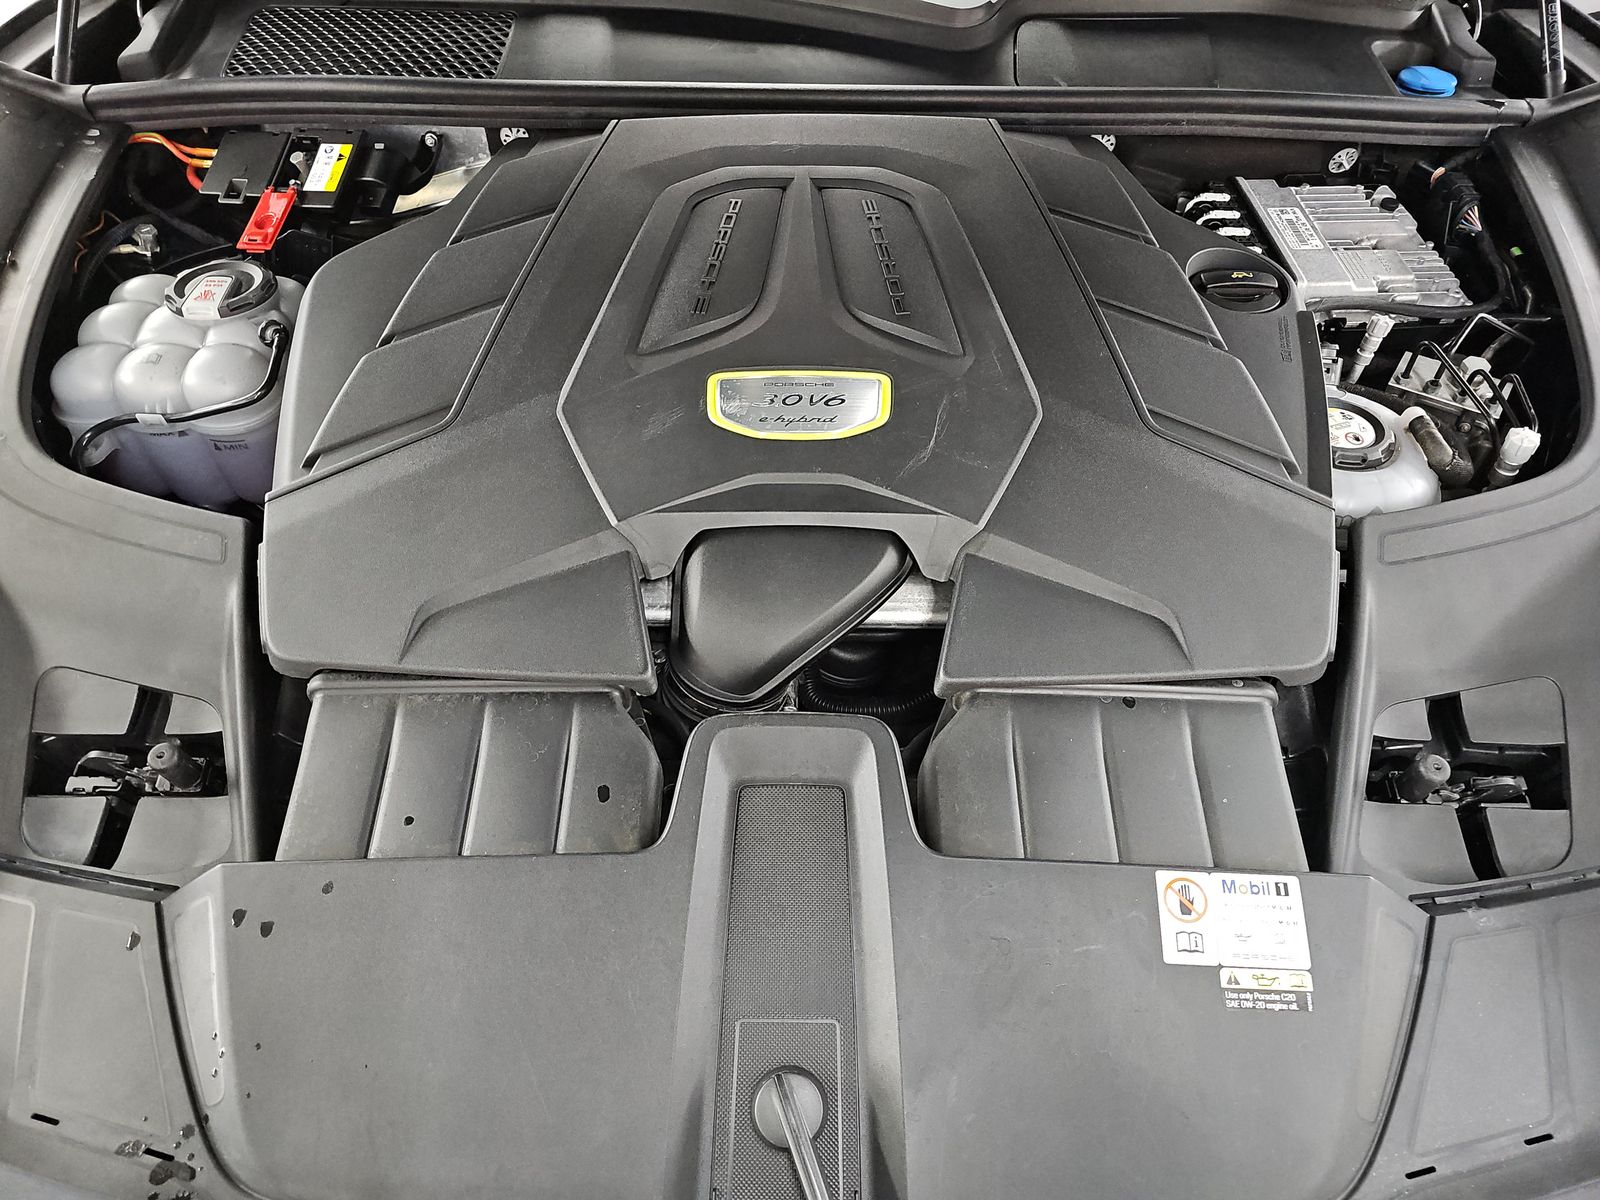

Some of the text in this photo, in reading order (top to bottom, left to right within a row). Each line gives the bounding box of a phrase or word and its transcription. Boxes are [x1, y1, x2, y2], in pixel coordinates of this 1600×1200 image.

[690, 198, 743, 315] PORSCHE
[861, 199, 911, 316] PORSCHE
[759, 414, 839, 427] e-hybrid
[1221, 879, 1289, 896] Mobil 1
[1224, 990, 1296, 1001] Use only Porsche C20
[1225, 999, 1241, 1008] SAE
[1265, 1002, 1289, 1011] engine
